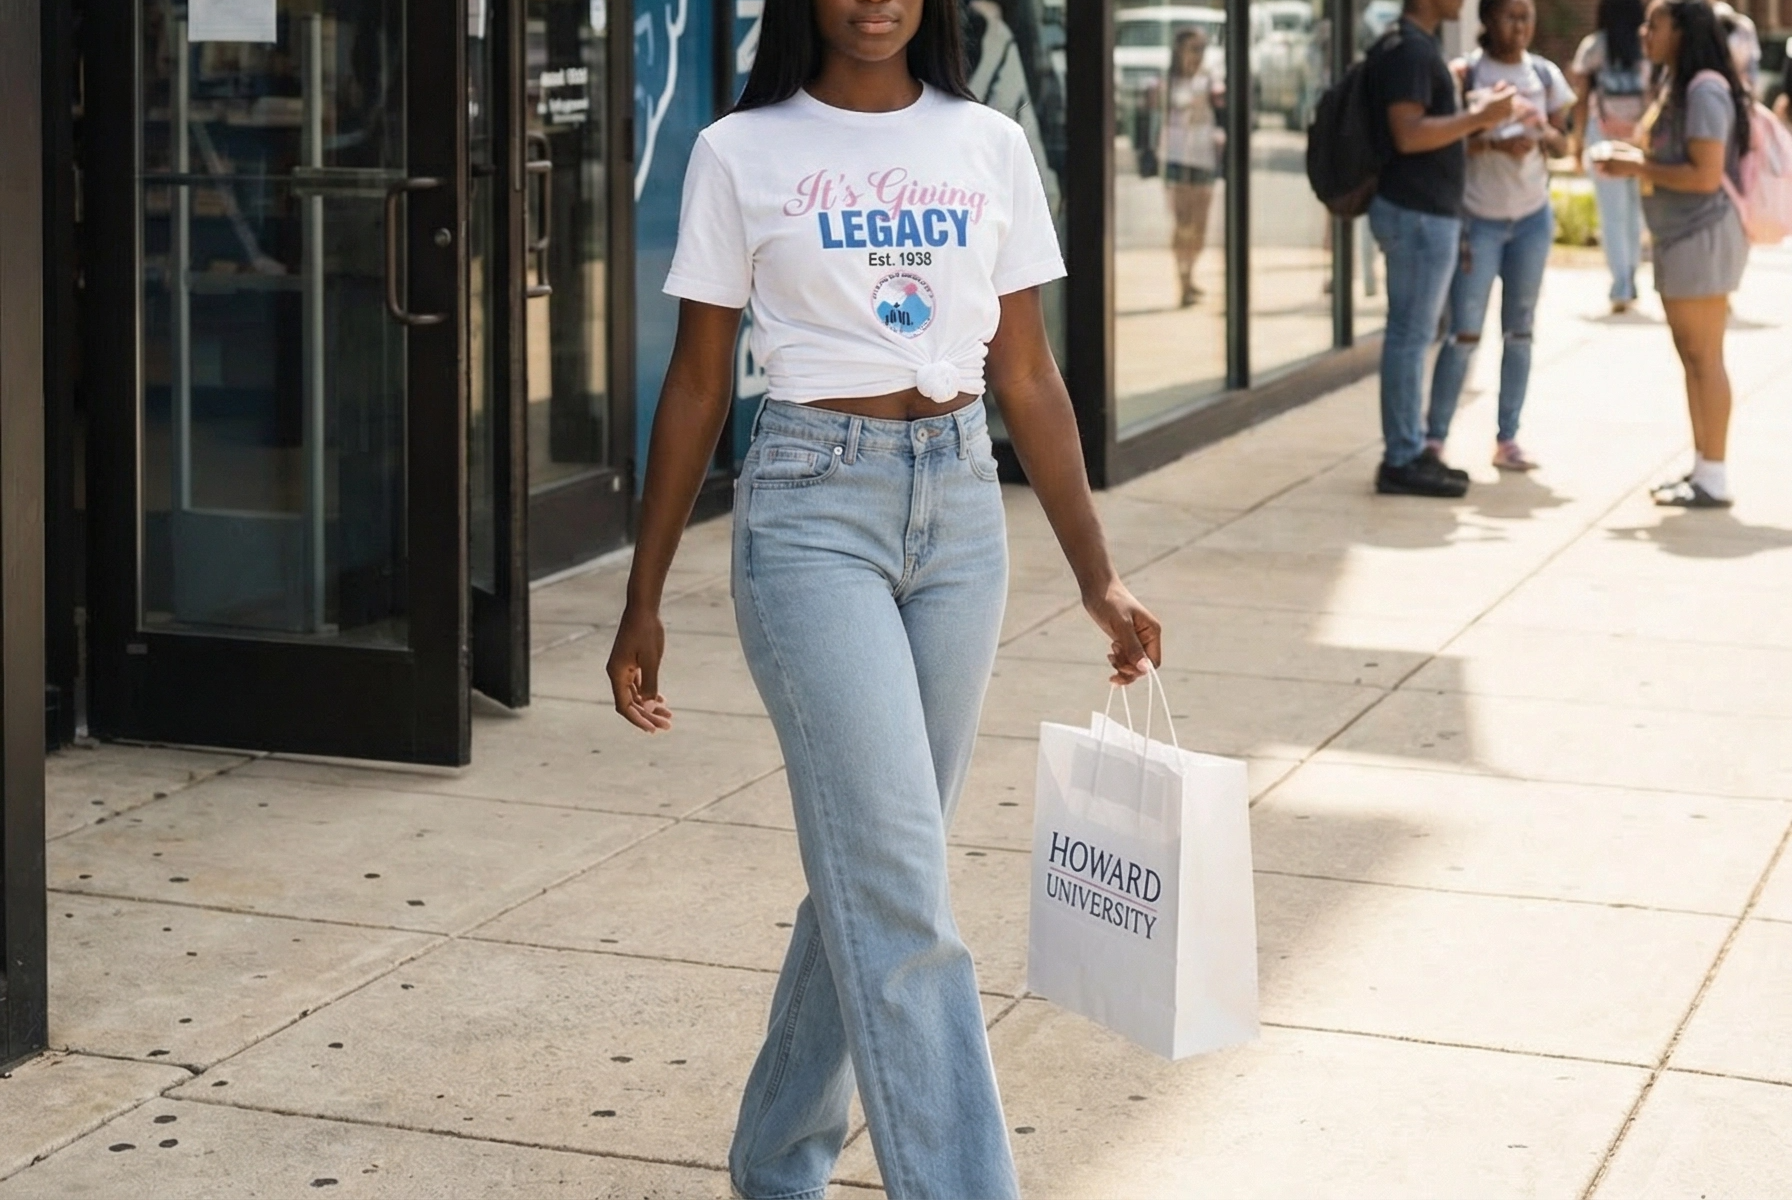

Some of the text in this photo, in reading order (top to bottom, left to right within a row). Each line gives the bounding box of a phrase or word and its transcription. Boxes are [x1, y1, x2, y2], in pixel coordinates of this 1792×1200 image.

[783, 167, 989, 225] It's Giving
[818, 208, 969, 249] LEGACY
[868, 252, 932, 267] Est. 1938
[1049, 831, 1161, 903] HOWARD
[1046, 873, 1157, 939] UNIVERSITY
